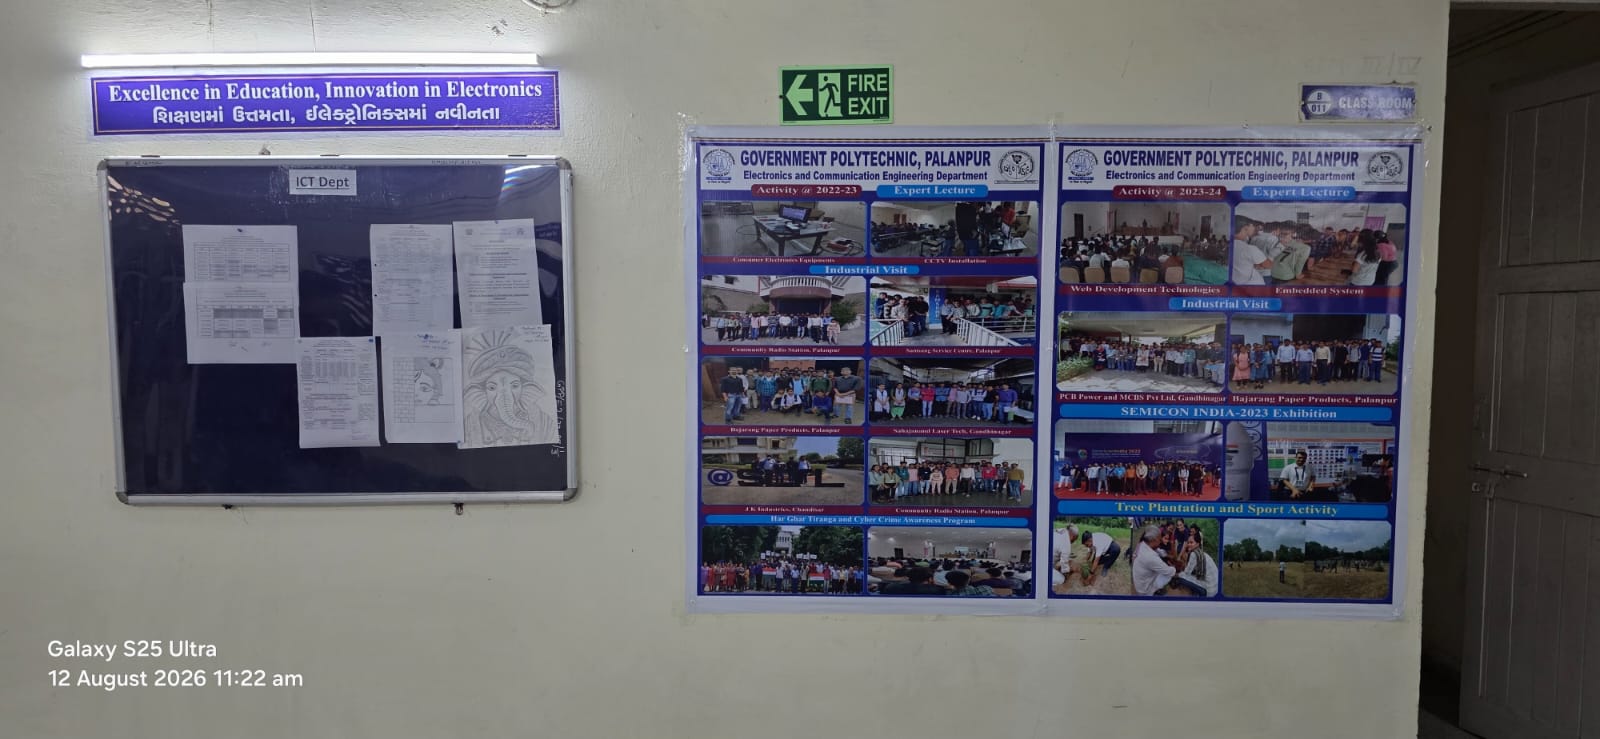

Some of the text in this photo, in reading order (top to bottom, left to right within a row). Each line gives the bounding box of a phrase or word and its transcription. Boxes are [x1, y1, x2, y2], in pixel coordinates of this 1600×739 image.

[848, 74, 888, 92] FIRE
[109, 80, 542, 102] Excellence in Education, Innovation in Electronics
[848, 97, 888, 115] EXIT
[1311, 104, 1326, 113] 011
[1338, 97, 1412, 109] CLASS ROOM
[153, 105, 224, 124] શિક્ષણમાં
[434, 103, 500, 120] નવીનતા
[740, 150, 827, 167] GOVERNMENT
[830, 150, 922, 169] POLYTECHNIC,
[925, 150, 991, 167] PALANPUR
[1104, 150, 1359, 170] GOVERNMENT POLYTECHNIC, PALANPUR
[744, 170, 988, 182] Electronics and Communication Engineering Department
[1106, 170, 1355, 182] Electronics and Communication Engineering Department
[296, 176, 350, 190] ICT Dept
[756, 186, 858, 195] Activity @ 2022-23
[894, 186, 976, 196] Expert Lecture
[1120, 188, 1162, 198] Activity
[1179, 188, 1222, 196] 2023-24
[1252, 188, 1350, 198] Expert Lecture
[825, 265, 908, 274] Industrial Visit
[1095, 285, 1157, 294] Development
[1160, 286, 1220, 294] Technologies
[1275, 287, 1364, 296] Embedded System
[1182, 300, 1269, 309] Industrial Visit
[1178, 395, 1226, 403] Gandhinagar
[1232, 396, 1276, 404] Bajarang
[1278, 396, 1306, 404] Paper
[1308, 396, 1352, 404] Products,
[1121, 406, 1337, 418] SEMICON INDIA-2023 Exhibition
[1115, 502, 1338, 518] Tree Plantation and Sport Activity
[807, 516, 838, 524] Tiranga
[854, 516, 876, 524] Cyber
[878, 516, 901, 524] Crime
[904, 516, 941, 524] Awareness
[942, 517, 976, 525] Program
